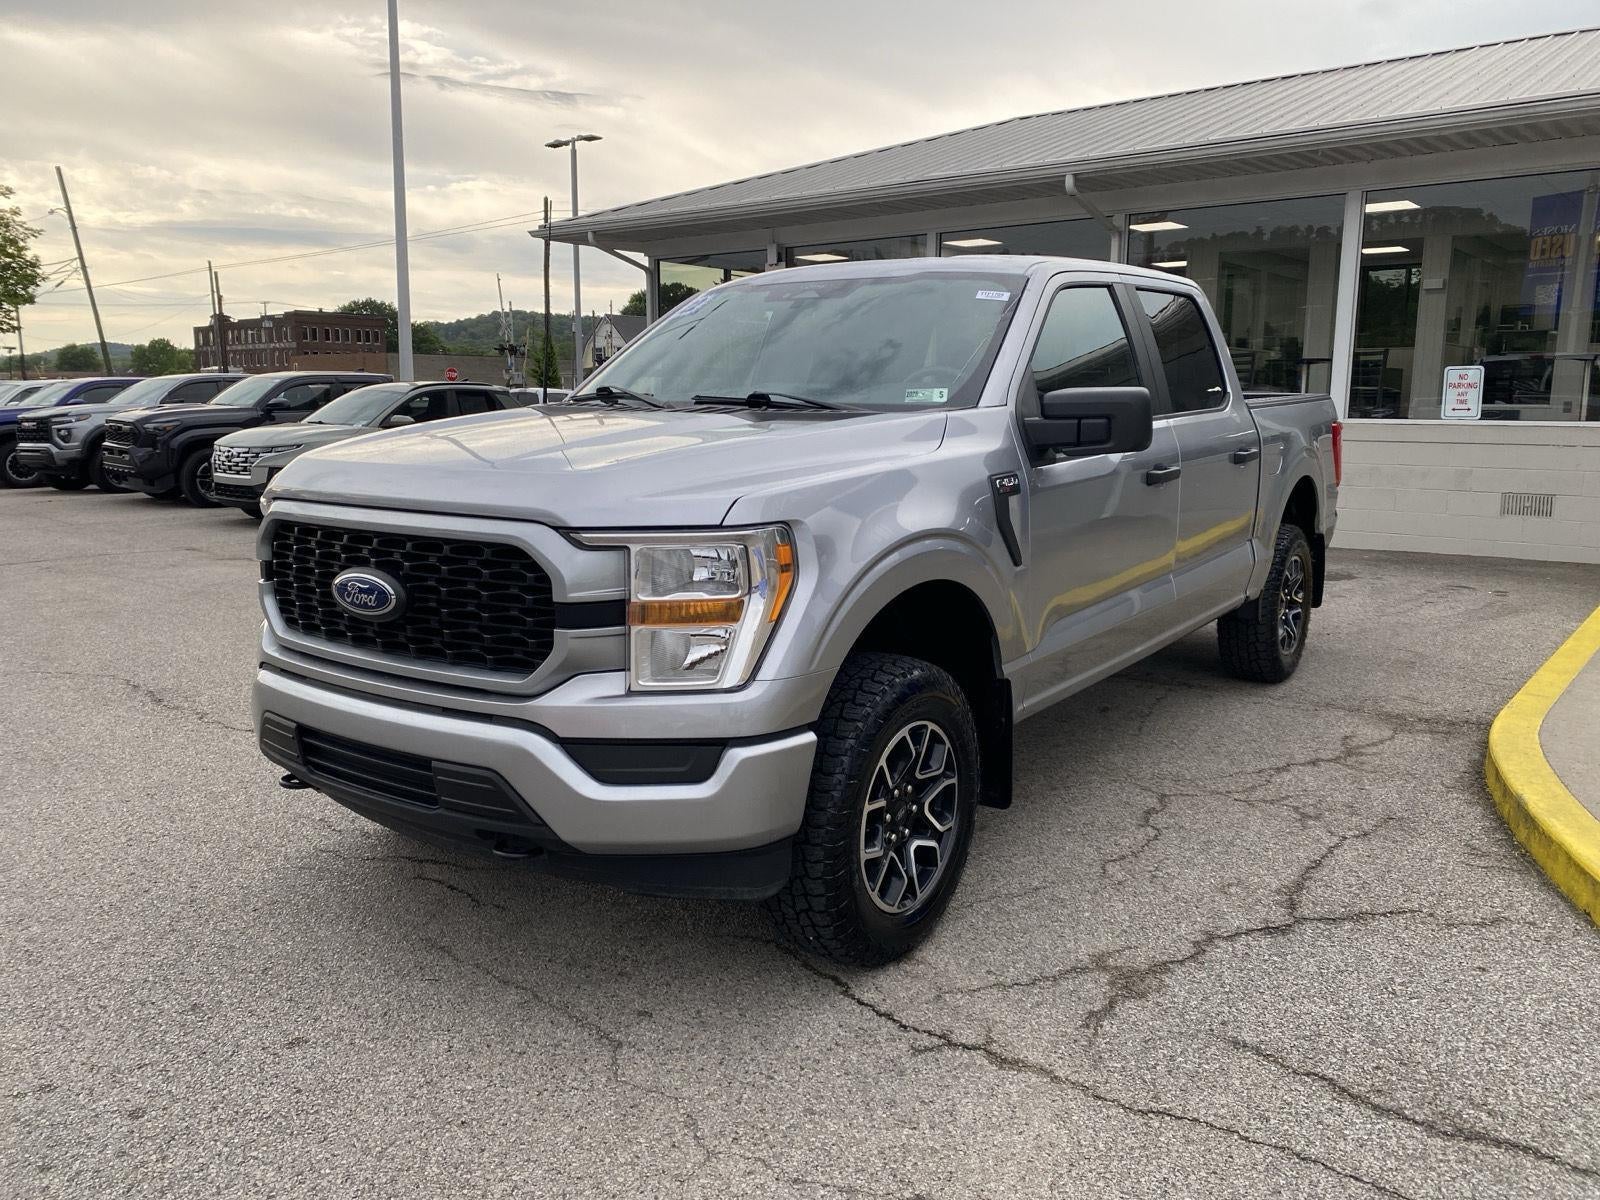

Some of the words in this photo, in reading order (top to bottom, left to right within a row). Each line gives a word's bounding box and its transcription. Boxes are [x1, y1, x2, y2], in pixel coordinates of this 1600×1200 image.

[1458, 373, 1469, 381] NO
[1448, 382, 1478, 390] PARKING
[344, 581, 378, 606] Ford
